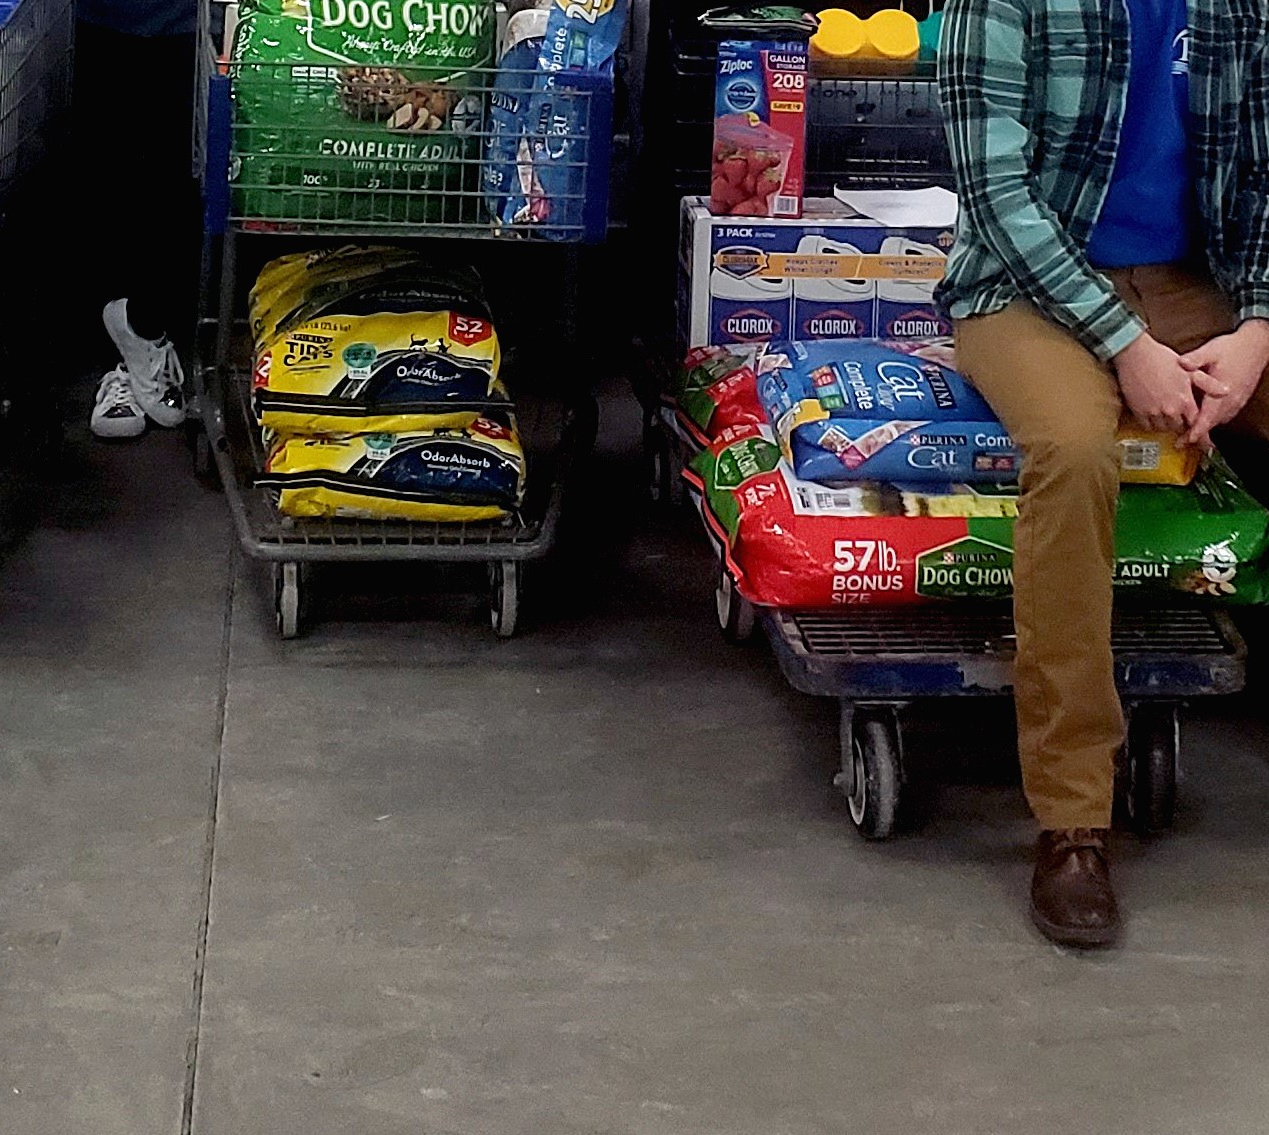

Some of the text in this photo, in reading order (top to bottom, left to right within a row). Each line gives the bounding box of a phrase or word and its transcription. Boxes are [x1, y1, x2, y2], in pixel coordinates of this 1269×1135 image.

[720, 58, 753, 75] Ziploc
[769, 54, 806, 64] GALLON
[772, 74, 805, 89] 208
[319, 138, 415, 158] COMPLETE
[716, 228, 753, 238] 3 PACK
[454, 317, 483, 333] 52
[727, 318, 773, 334] CLOROX
[810, 319, 857, 335] CLOROX
[893, 320, 940, 336] CLOROX
[843, 361, 873, 410] Complete
[877, 360, 925, 404] Cat
[477, 417, 504, 434] 52
[920, 435, 965, 445] PURINA
[420, 450, 491, 468] OdorAbsorb
[907, 446, 959, 469] Cat
[954, 553, 997, 563] PURINA
[1121, 564, 1170, 578] ADULT
[832, 575, 904, 592] BONUS
[830, 593, 873, 605] SIZE
